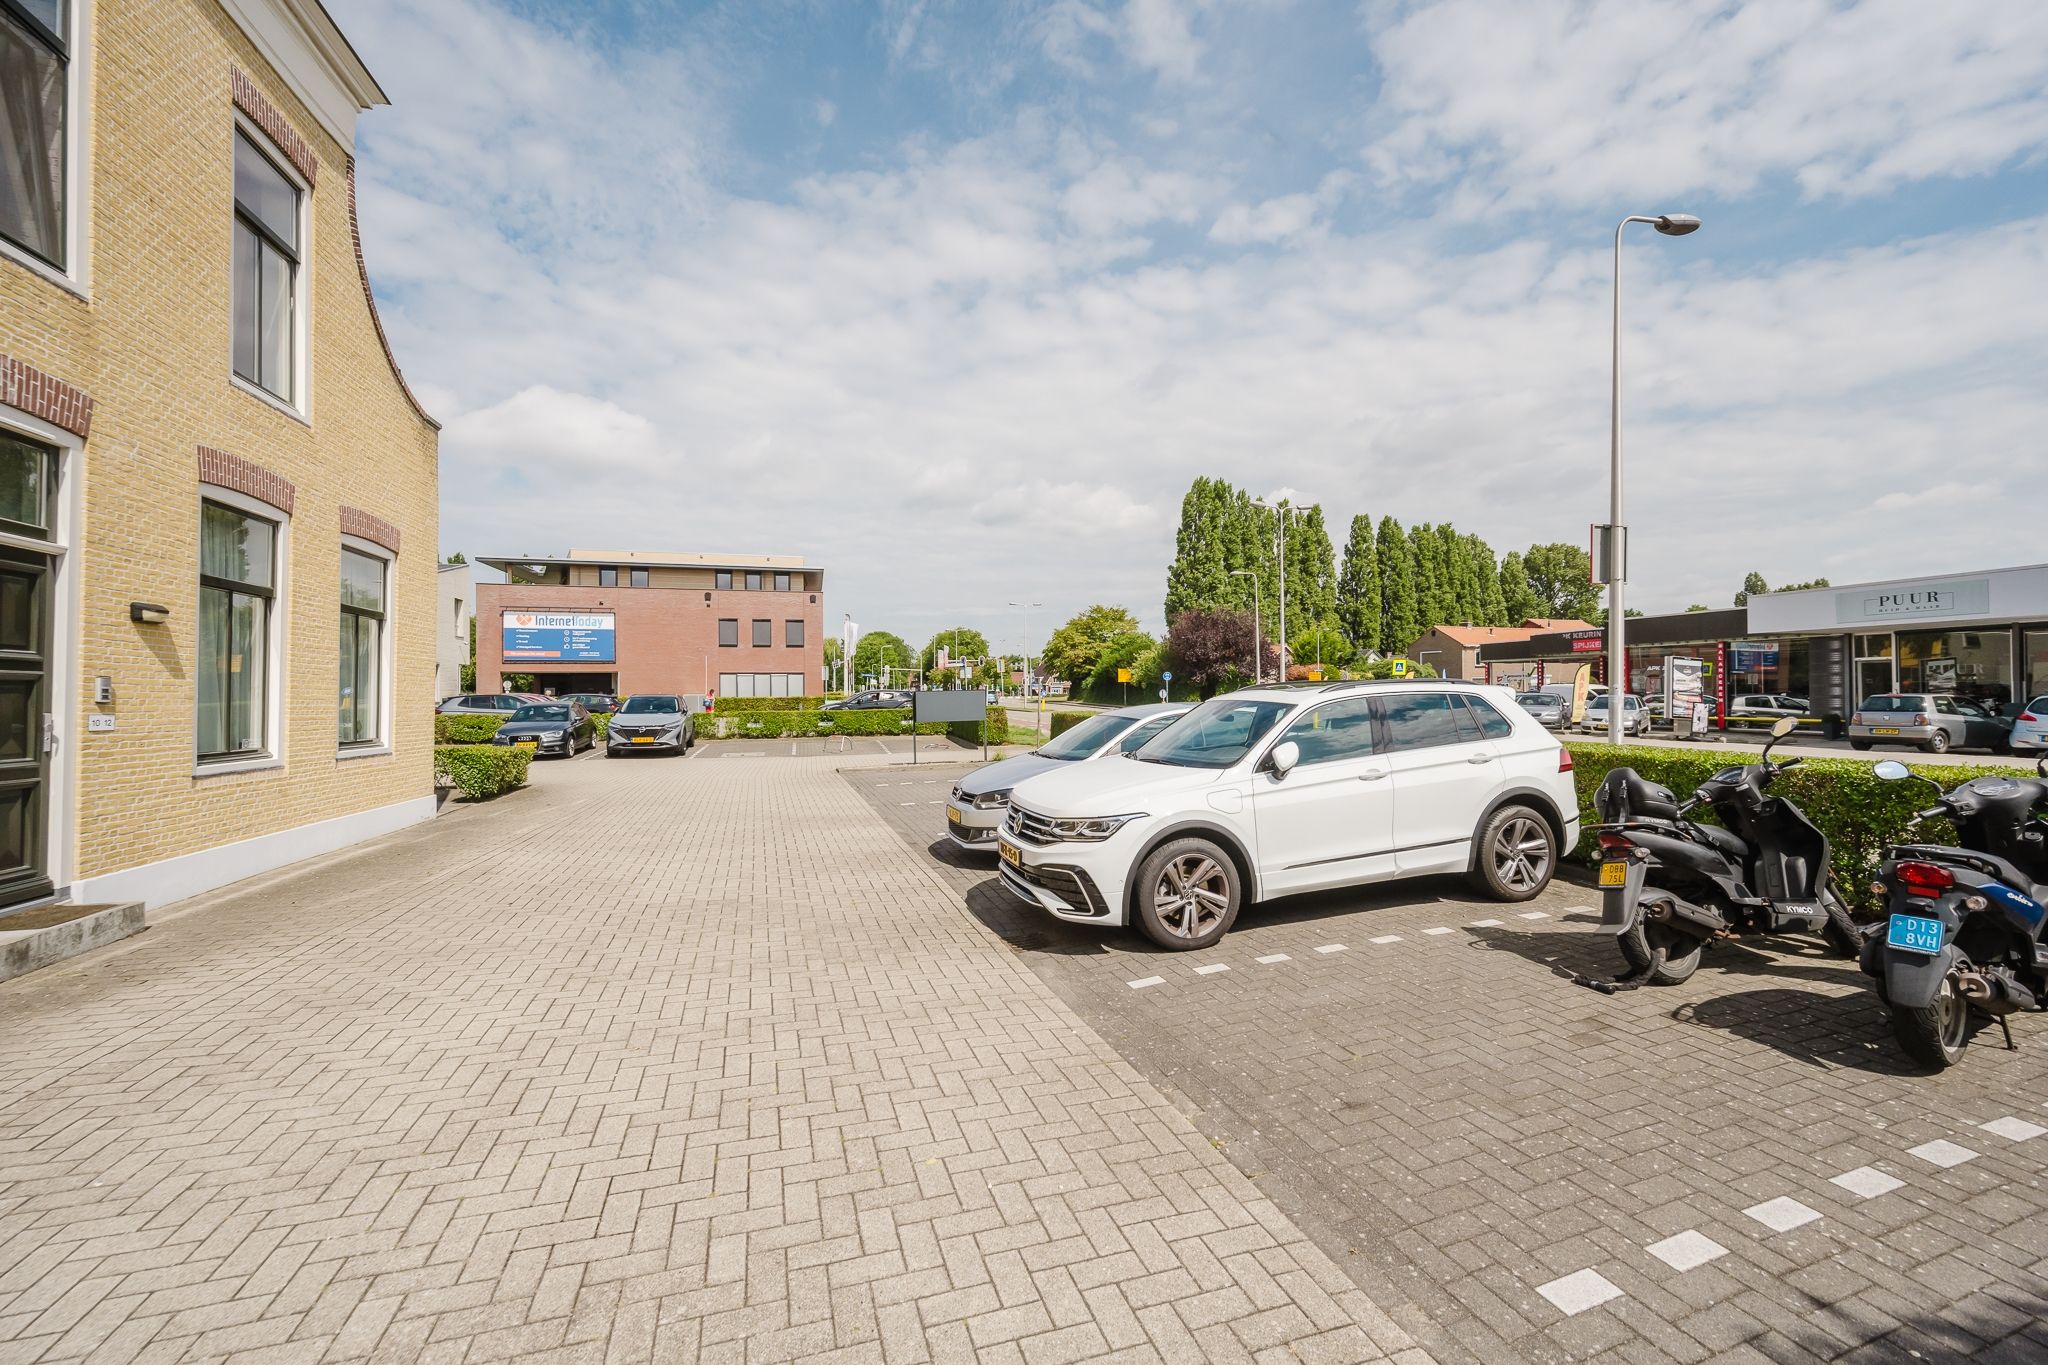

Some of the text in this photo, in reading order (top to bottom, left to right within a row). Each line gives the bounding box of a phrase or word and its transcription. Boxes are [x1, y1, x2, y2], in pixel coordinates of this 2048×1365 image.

[1879, 591, 1940, 607] PUUR
[535, 615, 603, 629] InternetToday
[1572, 641, 1602, 649] SPIJKE
[91, 719, 112, 727] 10 12
[1786, 905, 1814, 914] KYMCO
[1907, 919, 1938, 934] D13
[1905, 932, 1937, 948] 8VH
